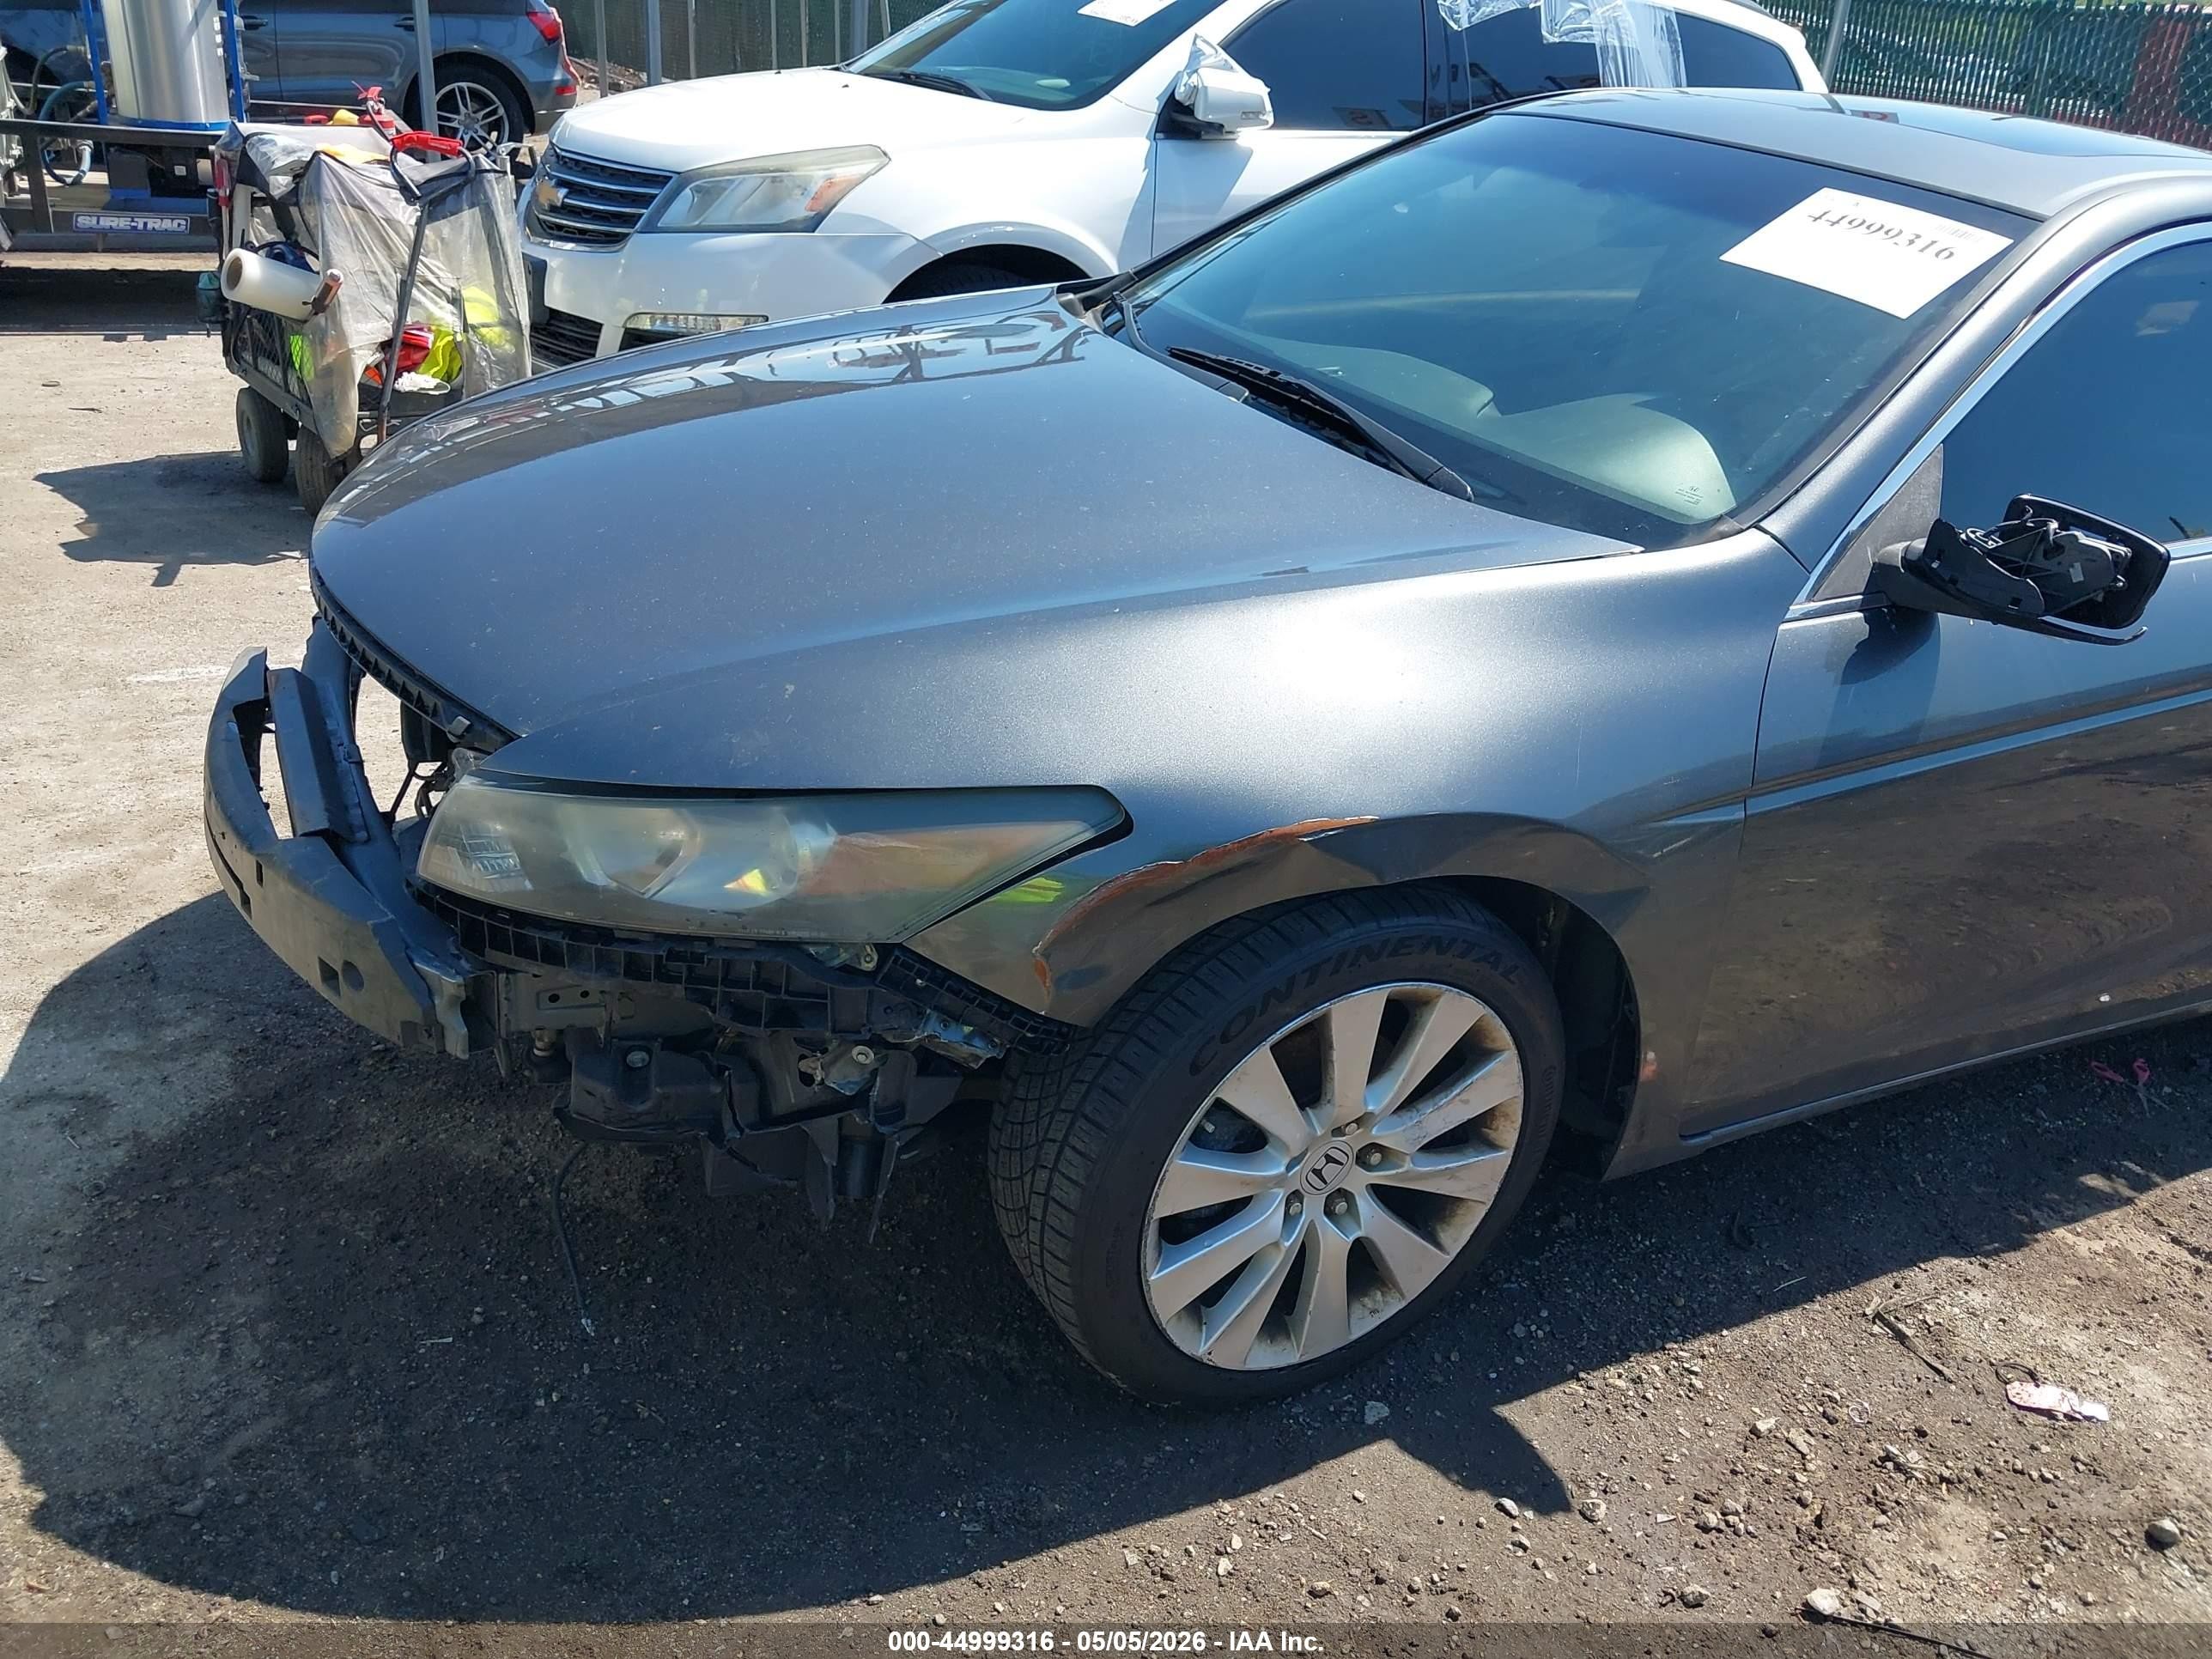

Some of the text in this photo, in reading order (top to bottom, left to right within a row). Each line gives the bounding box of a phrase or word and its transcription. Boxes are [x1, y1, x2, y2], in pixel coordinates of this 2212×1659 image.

[76, 216, 186, 231] SURE-TRAC
[1808, 210, 1954, 260] 44999316
[1188, 933, 1522, 1076] CONTINENTAL
